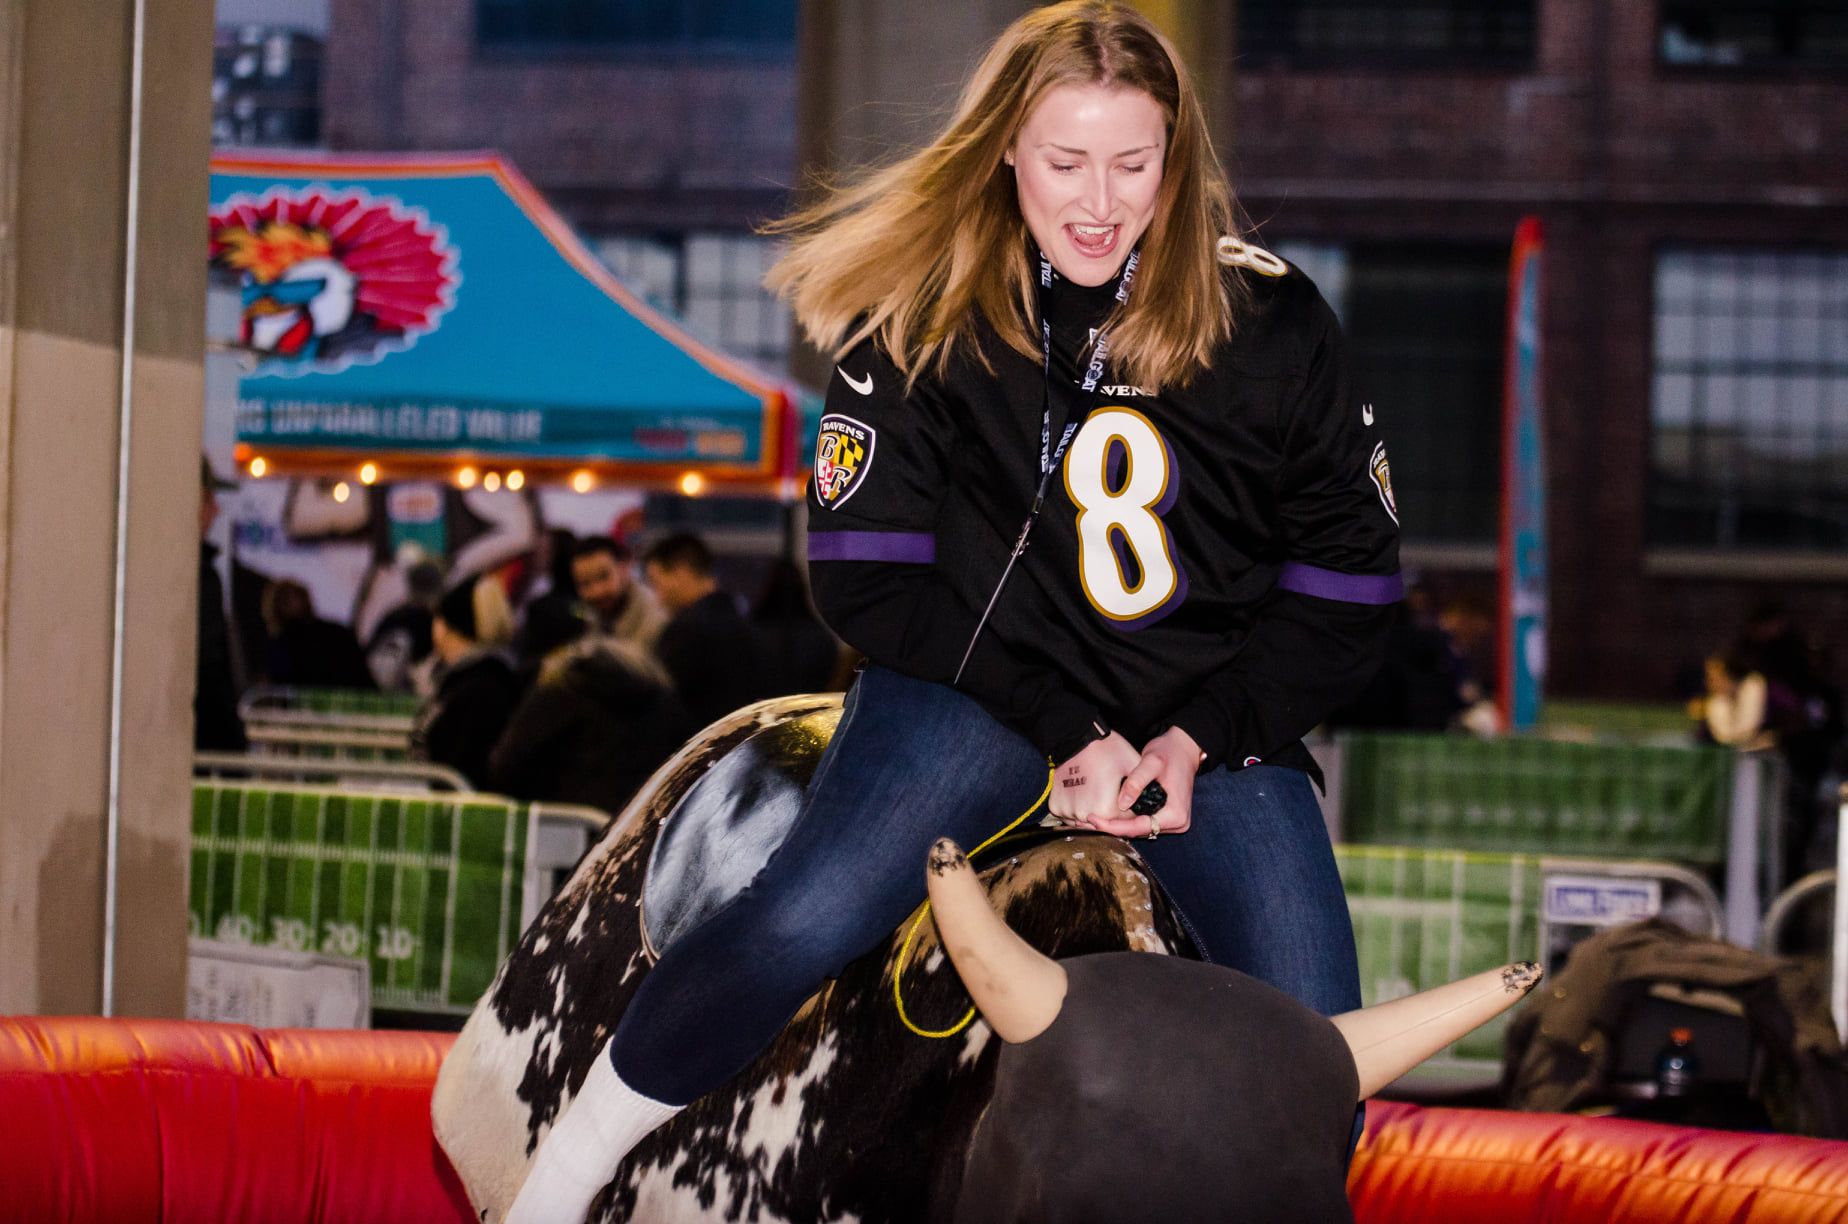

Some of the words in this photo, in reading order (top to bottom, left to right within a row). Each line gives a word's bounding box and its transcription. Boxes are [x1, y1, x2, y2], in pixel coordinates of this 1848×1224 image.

[1217, 236, 1290, 277] 8
[822, 422, 866, 440] RAVENS
[1063, 406, 1187, 632] 8
